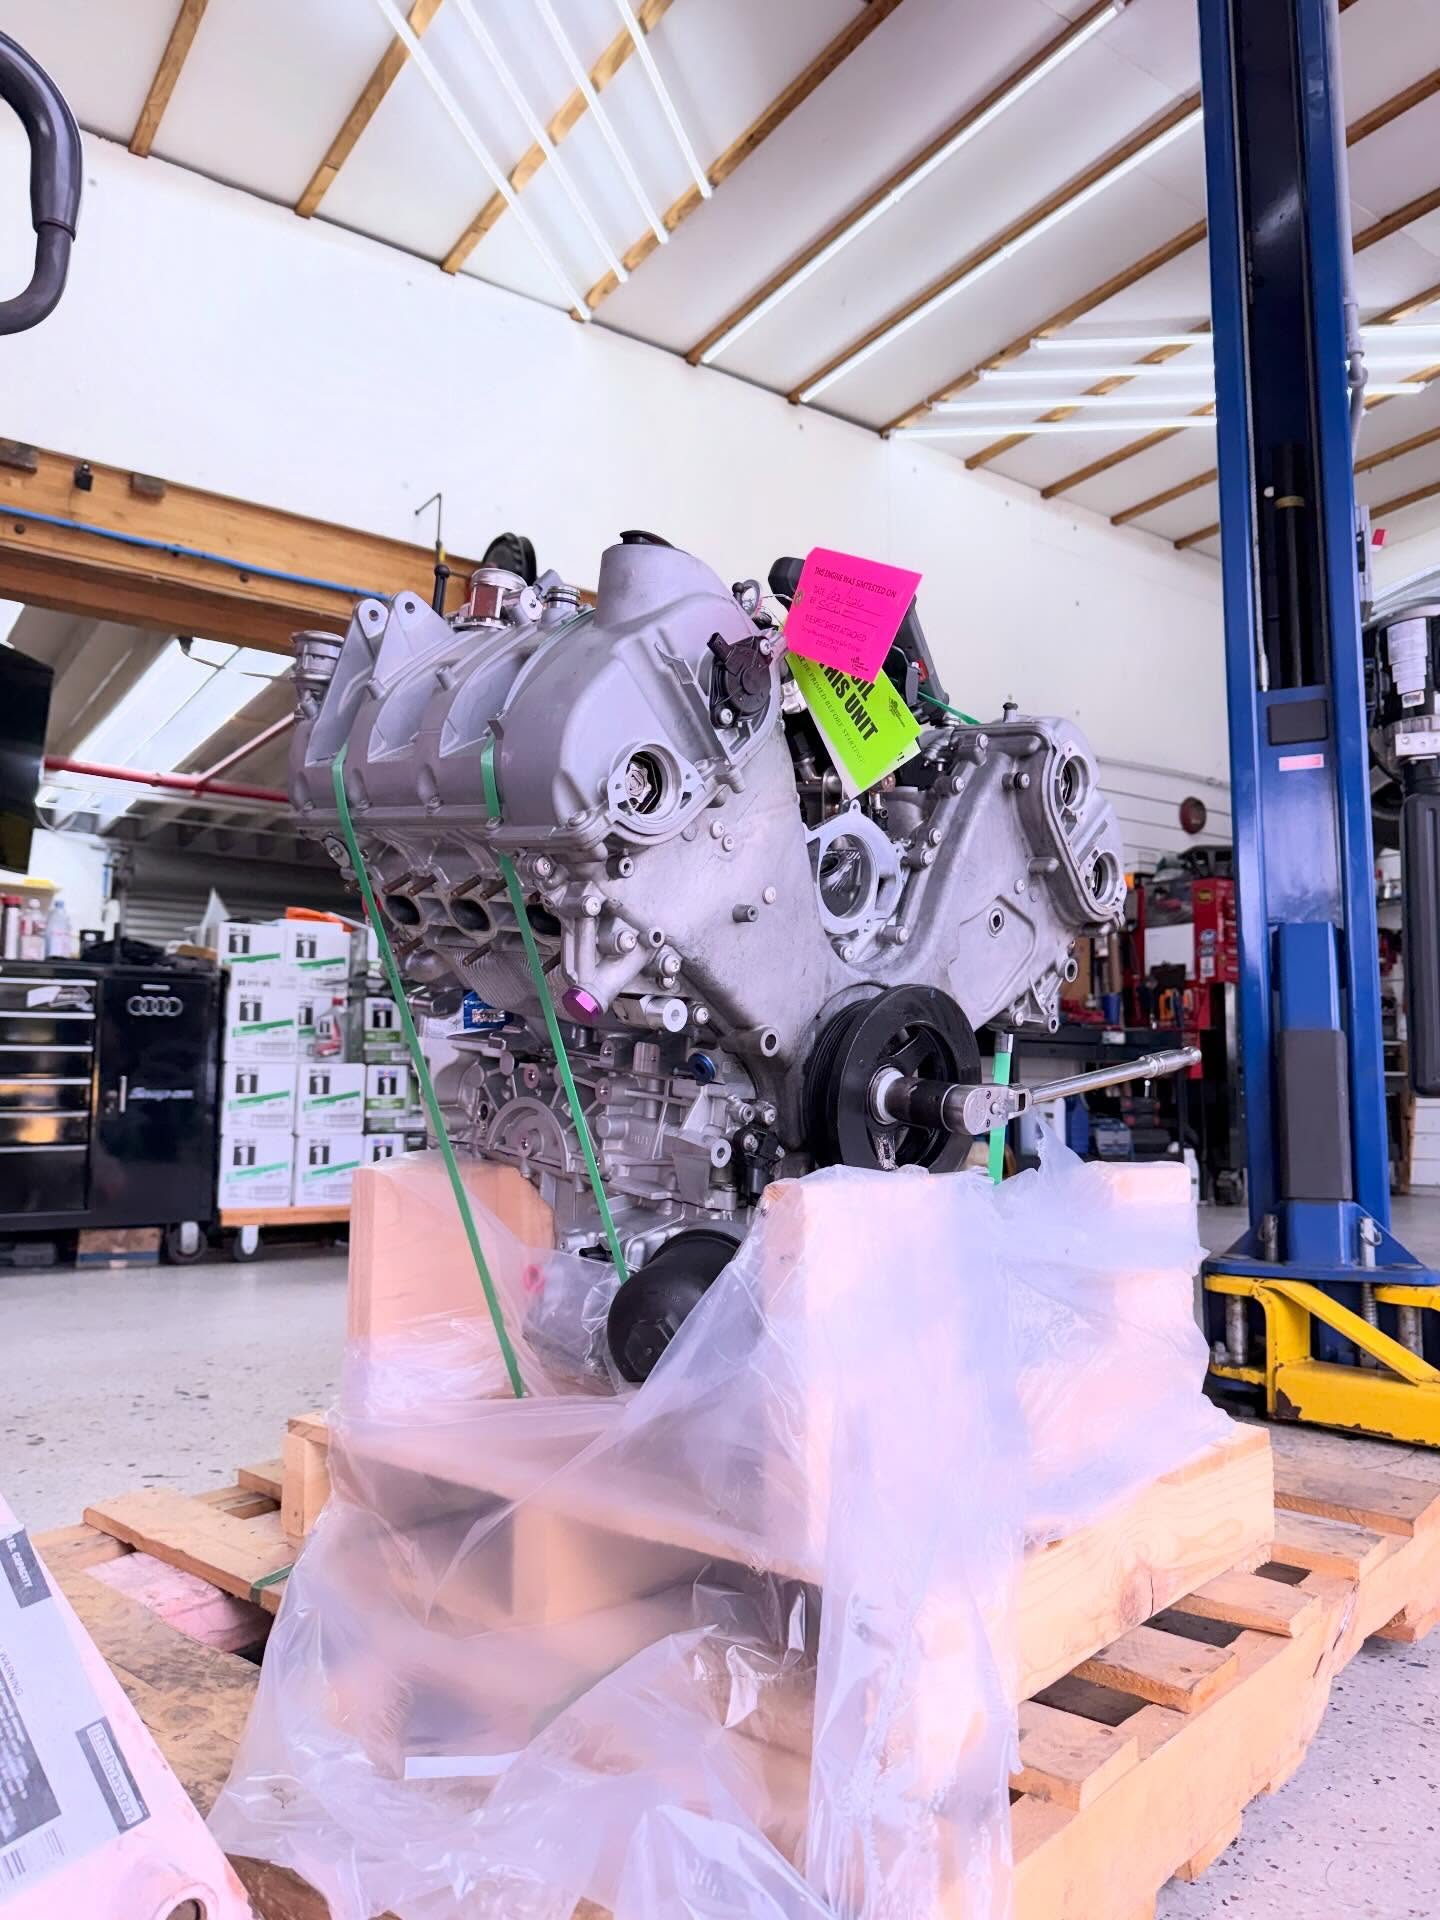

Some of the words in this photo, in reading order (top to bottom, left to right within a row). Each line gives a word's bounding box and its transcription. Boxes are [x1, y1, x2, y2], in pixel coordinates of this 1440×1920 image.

[824, 569, 843, 581] ENGINE
[843, 574, 857, 586] WAS
[884, 587, 897, 599] ON
[818, 663, 850, 699] HIS
[844, 692, 879, 741] UNIT
[12, 1551, 33, 1588] CAPACITY
[0, 1650, 24, 1697] WARNING
